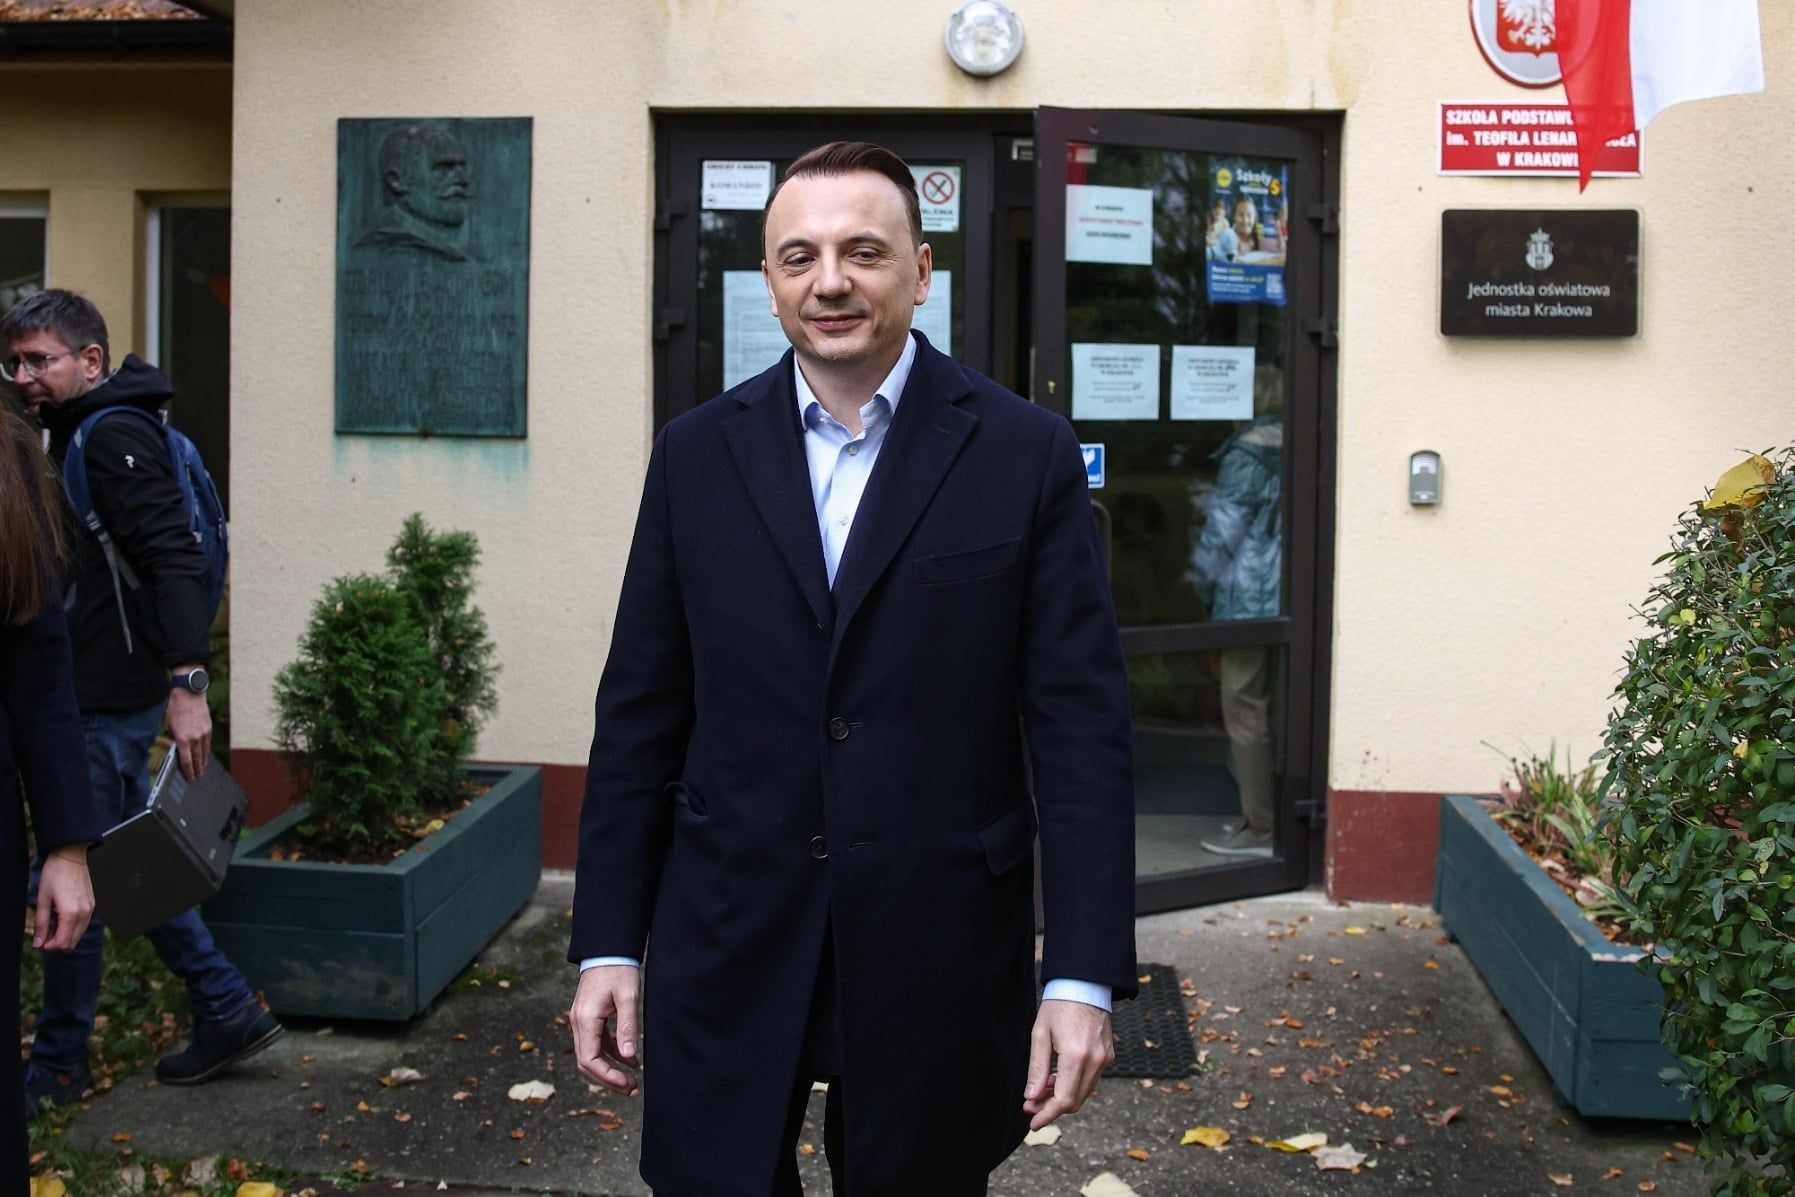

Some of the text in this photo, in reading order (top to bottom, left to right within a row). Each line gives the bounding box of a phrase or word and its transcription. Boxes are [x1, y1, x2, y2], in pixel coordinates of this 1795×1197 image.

[1446, 109, 1498, 125] SZKOŁA
[1446, 131, 1469, 146] im.
[1473, 131, 1530, 146] TEOFILA
[1497, 152, 1511, 167] W
[1467, 281, 1611, 300] Jednostka oświatowa
[1485, 302, 1593, 318] miasta Krakowa
